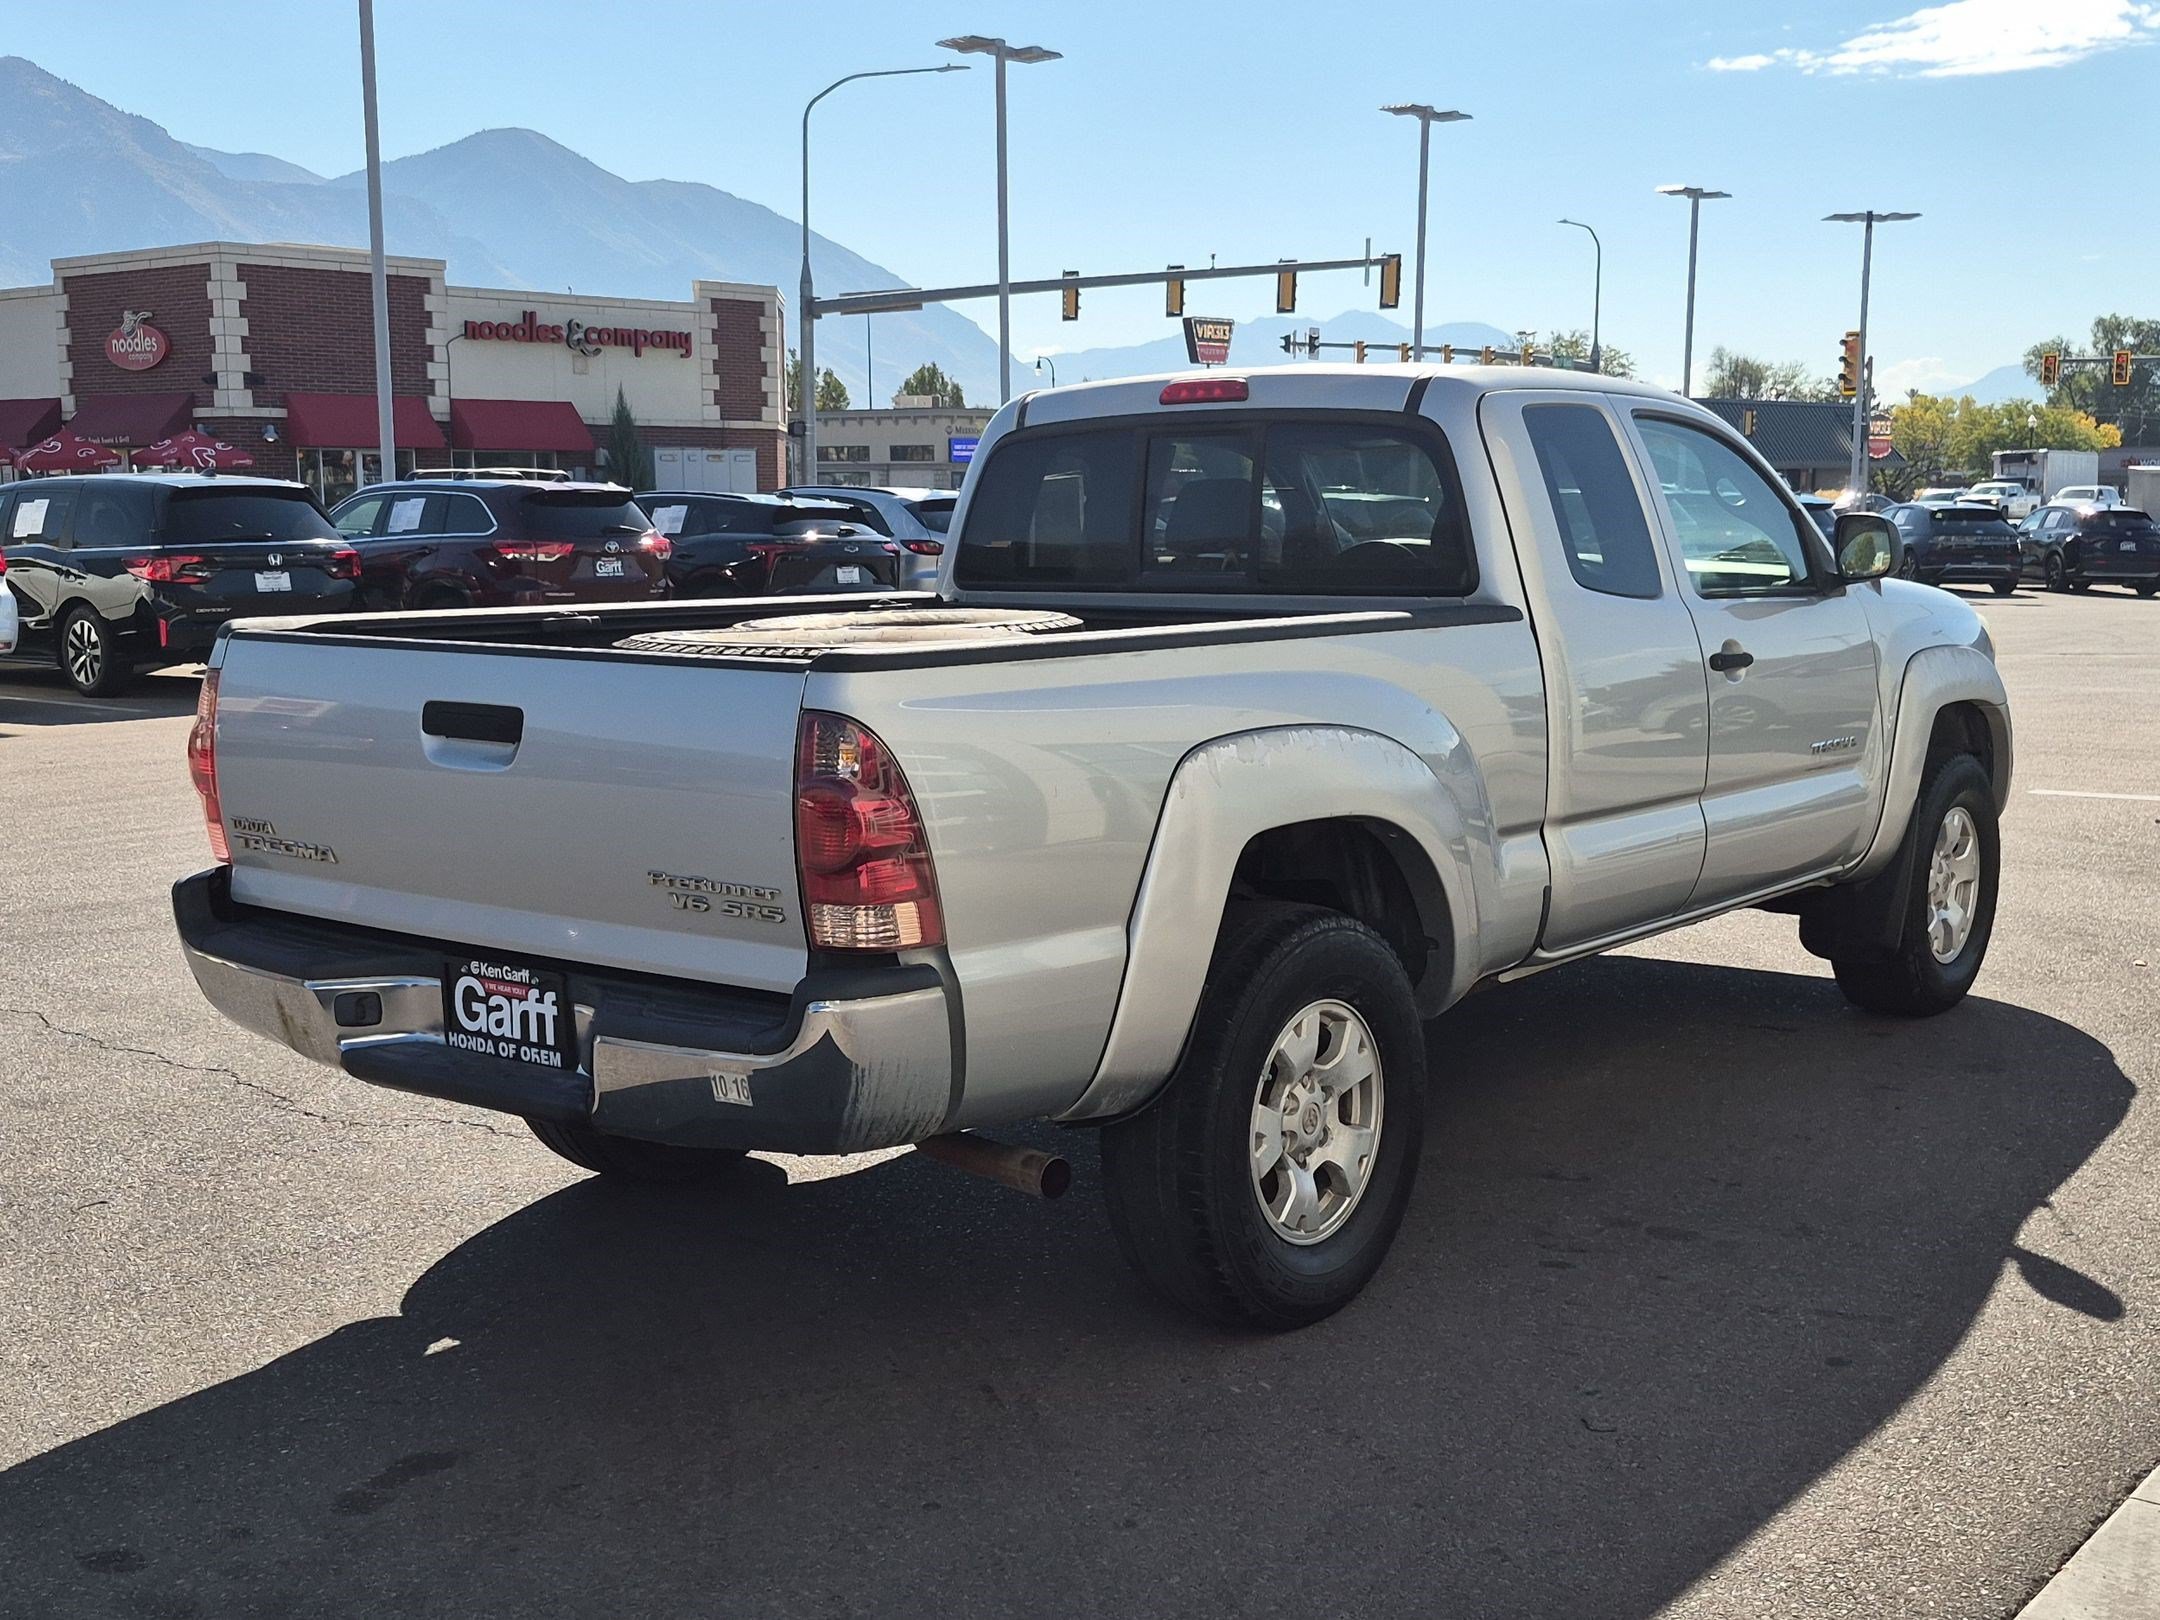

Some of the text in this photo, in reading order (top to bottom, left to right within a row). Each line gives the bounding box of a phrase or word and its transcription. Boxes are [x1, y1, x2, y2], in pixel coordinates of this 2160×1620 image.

[111, 327, 157, 353] noodles
[464, 310, 564, 342] noodles
[584, 327, 693, 359] company
[230, 815, 276, 835] TOYOTA
[233, 832, 339, 864] TACOMA
[647, 870, 781, 900] PreRunner
[667, 892, 711, 912] V6
[480, 962, 530, 984] Ken Garff
[454, 976, 558, 1046] Garff
[448, 1031, 562, 1068] HONDA OF OREM
[712, 1074, 750, 1100] 10 16
